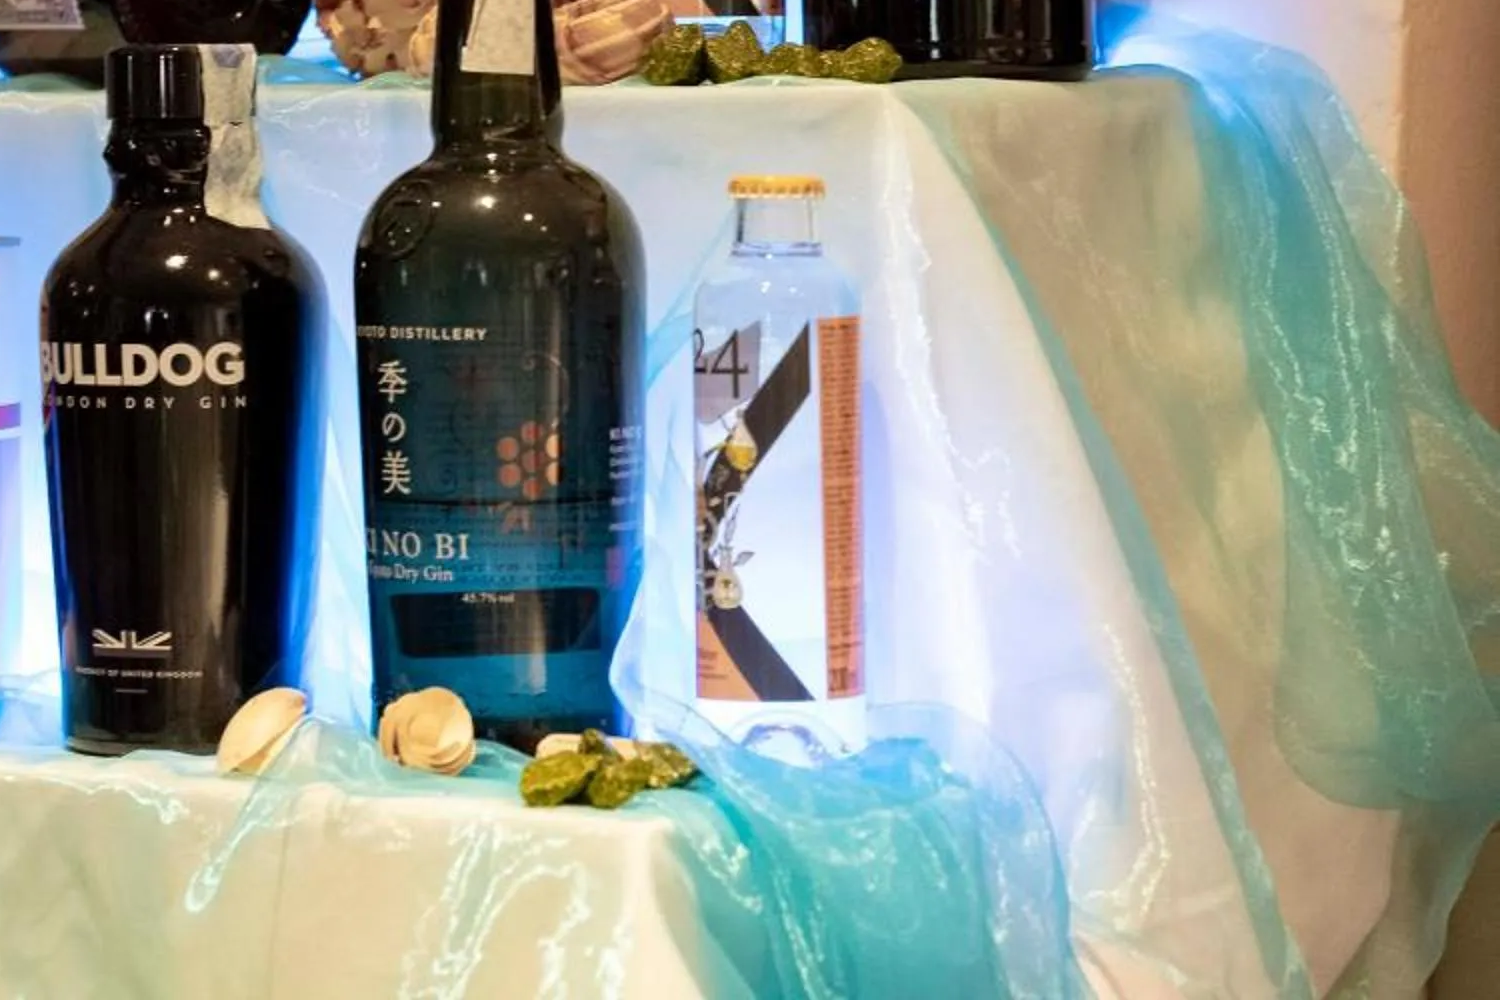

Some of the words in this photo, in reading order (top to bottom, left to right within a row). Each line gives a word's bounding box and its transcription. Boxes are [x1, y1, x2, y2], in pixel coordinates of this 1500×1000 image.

[389, 327, 487, 341] DISTILLERY
[40, 341, 245, 387] BULLDOG
[125, 397, 175, 409] DRY
[200, 396, 248, 409] GIN
[376, 359, 413, 496] 季の美
[436, 532, 470, 561] BI
[394, 563, 420, 584] Dry
[423, 565, 454, 582] Gin
